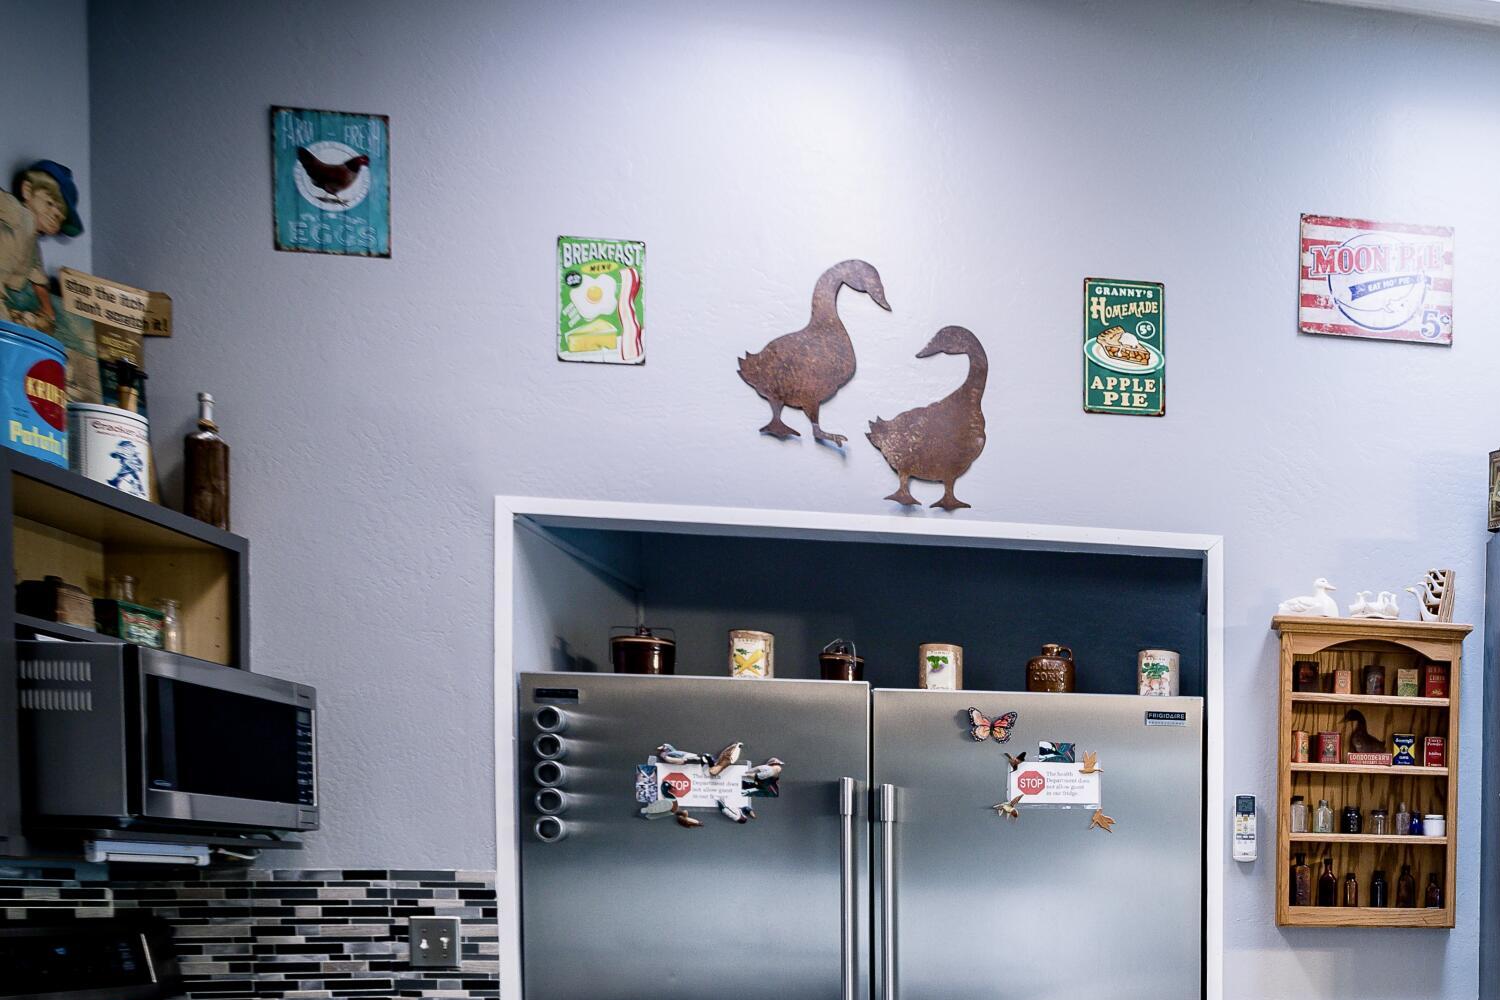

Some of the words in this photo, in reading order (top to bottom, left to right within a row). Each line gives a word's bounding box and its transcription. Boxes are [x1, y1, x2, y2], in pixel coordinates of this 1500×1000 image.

[288, 220, 377, 246] EGGS
[562, 242, 642, 269] BREAKFAST
[1311, 245, 1388, 275] MOON
[1400, 243, 1441, 270] PIE
[1095, 286, 1153, 298] GRANNY'S
[1090, 376, 1156, 393] APPLE
[1103, 391, 1148, 407] PIE
[1148, 712, 1185, 720] FRIGIDAIRE
[669, 780, 689, 791] TOP
[1020, 778, 1043, 788] STOP
